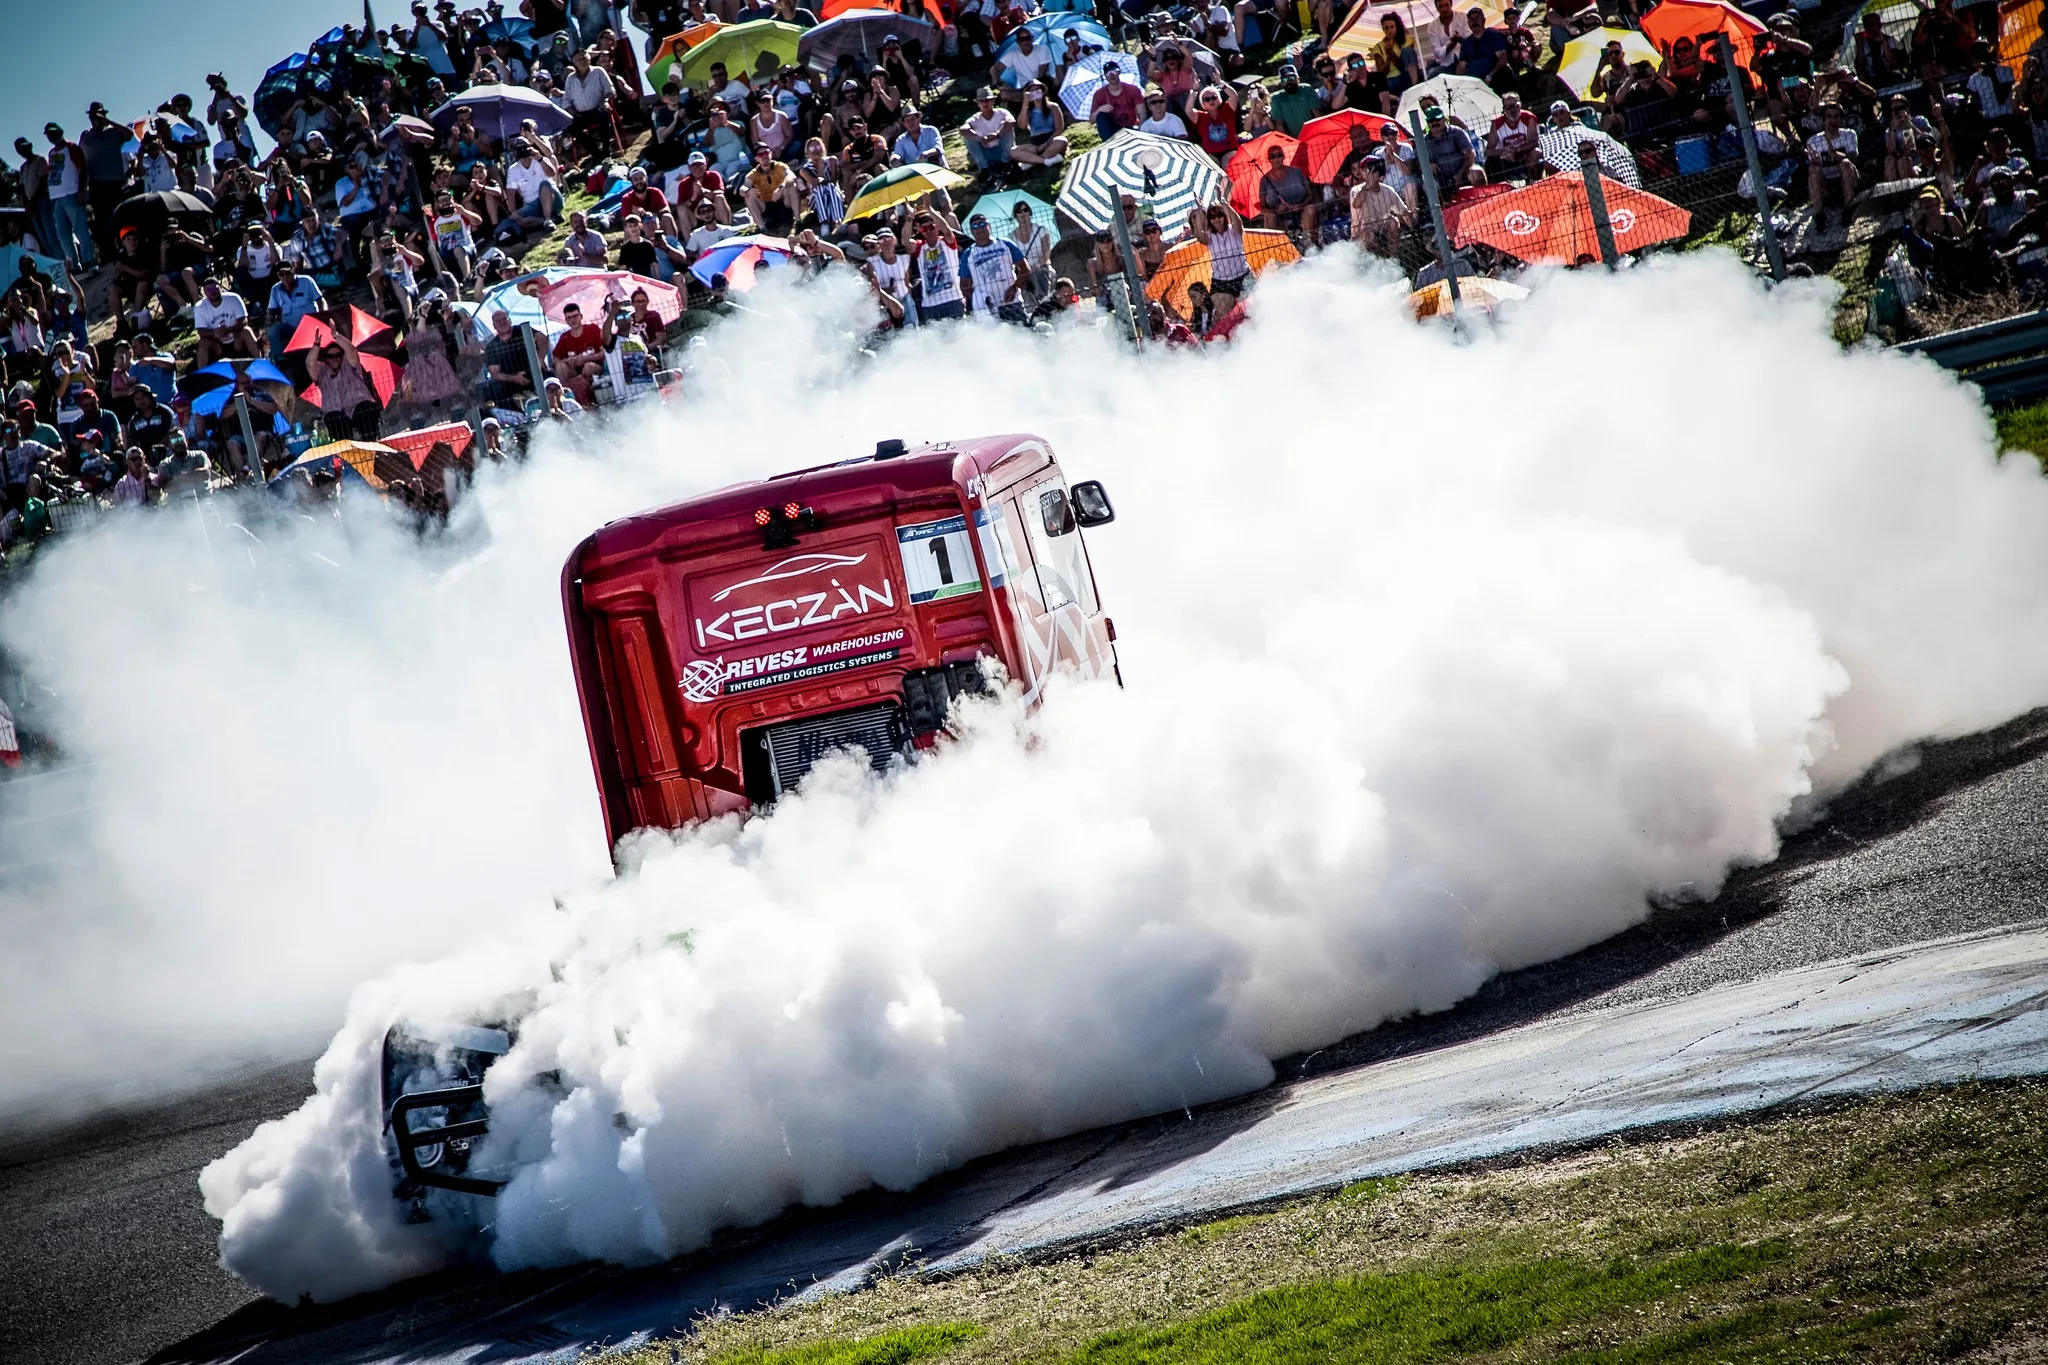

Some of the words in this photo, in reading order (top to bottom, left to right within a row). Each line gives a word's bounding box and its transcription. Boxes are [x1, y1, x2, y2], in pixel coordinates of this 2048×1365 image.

[928, 536, 954, 586] 1
[812, 629, 904, 657] WAREHOUSING
[729, 672, 791, 693] INTEGRATED
[793, 661, 846, 679] LOGISTICS
[848, 651, 893, 667] SYSTEMS
